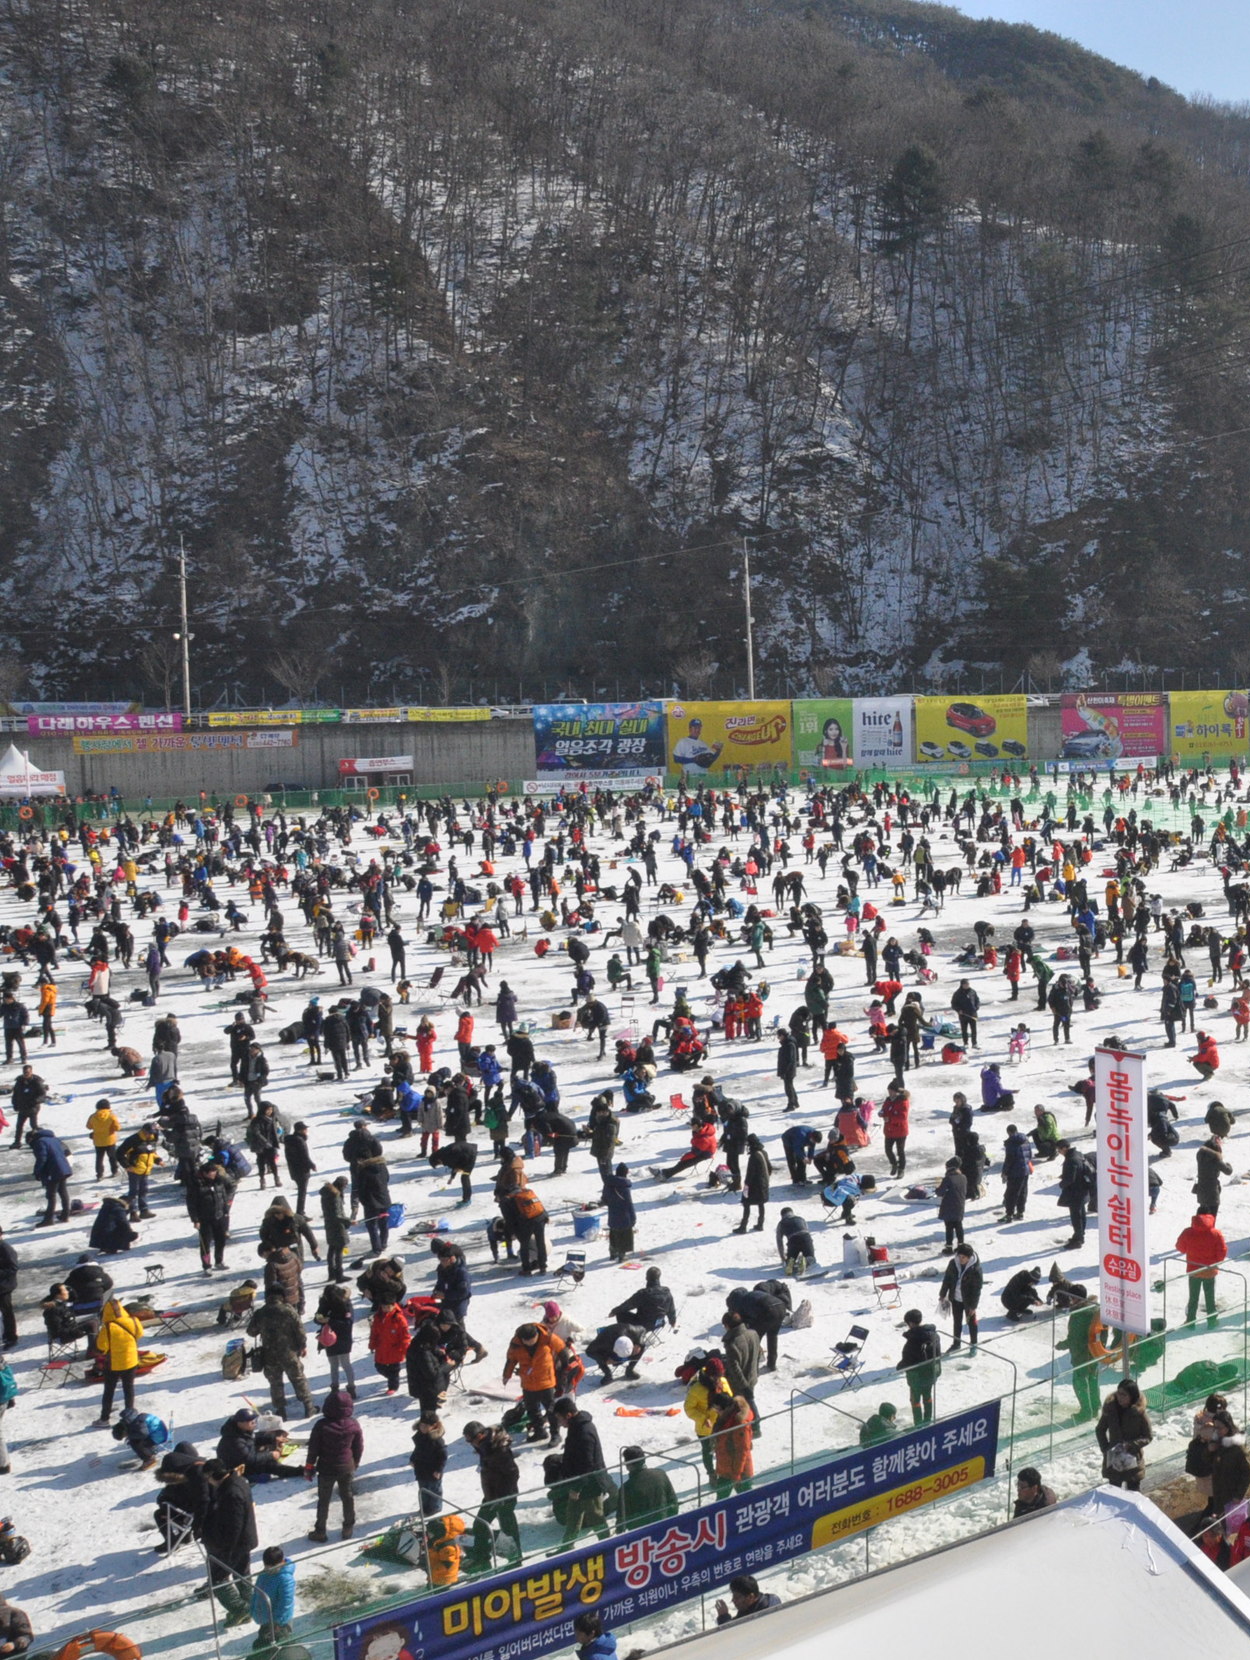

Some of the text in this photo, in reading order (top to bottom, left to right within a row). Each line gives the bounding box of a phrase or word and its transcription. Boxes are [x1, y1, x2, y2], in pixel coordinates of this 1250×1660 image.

[551, 718, 648, 737] 국내 최대 실내
[862, 712, 892, 726] hite
[152, 737, 186, 749] 가까운
[555, 738, 647, 756] 얼음조각 광장
[1106, 1070, 1134, 1254] 몸녹이는 쉼터
[1108, 1257, 1137, 1280] 수유실
[831, 1508, 872, 1536] 전화번호
[887, 1467, 969, 1512] 1688-3005
[443, 1418, 988, 1637] 미아발생 방송시 관광객 여러분도 함께찾아 주세요
[604, 1598, 635, 1621] 가까운
[638, 1582, 678, 1609] 직원이나
[681, 1568, 711, 1591] 우측의
[713, 1557, 742, 1579] 번호로
[745, 1546, 773, 1567] 연락을
[776, 1533, 803, 1556] 주세요
